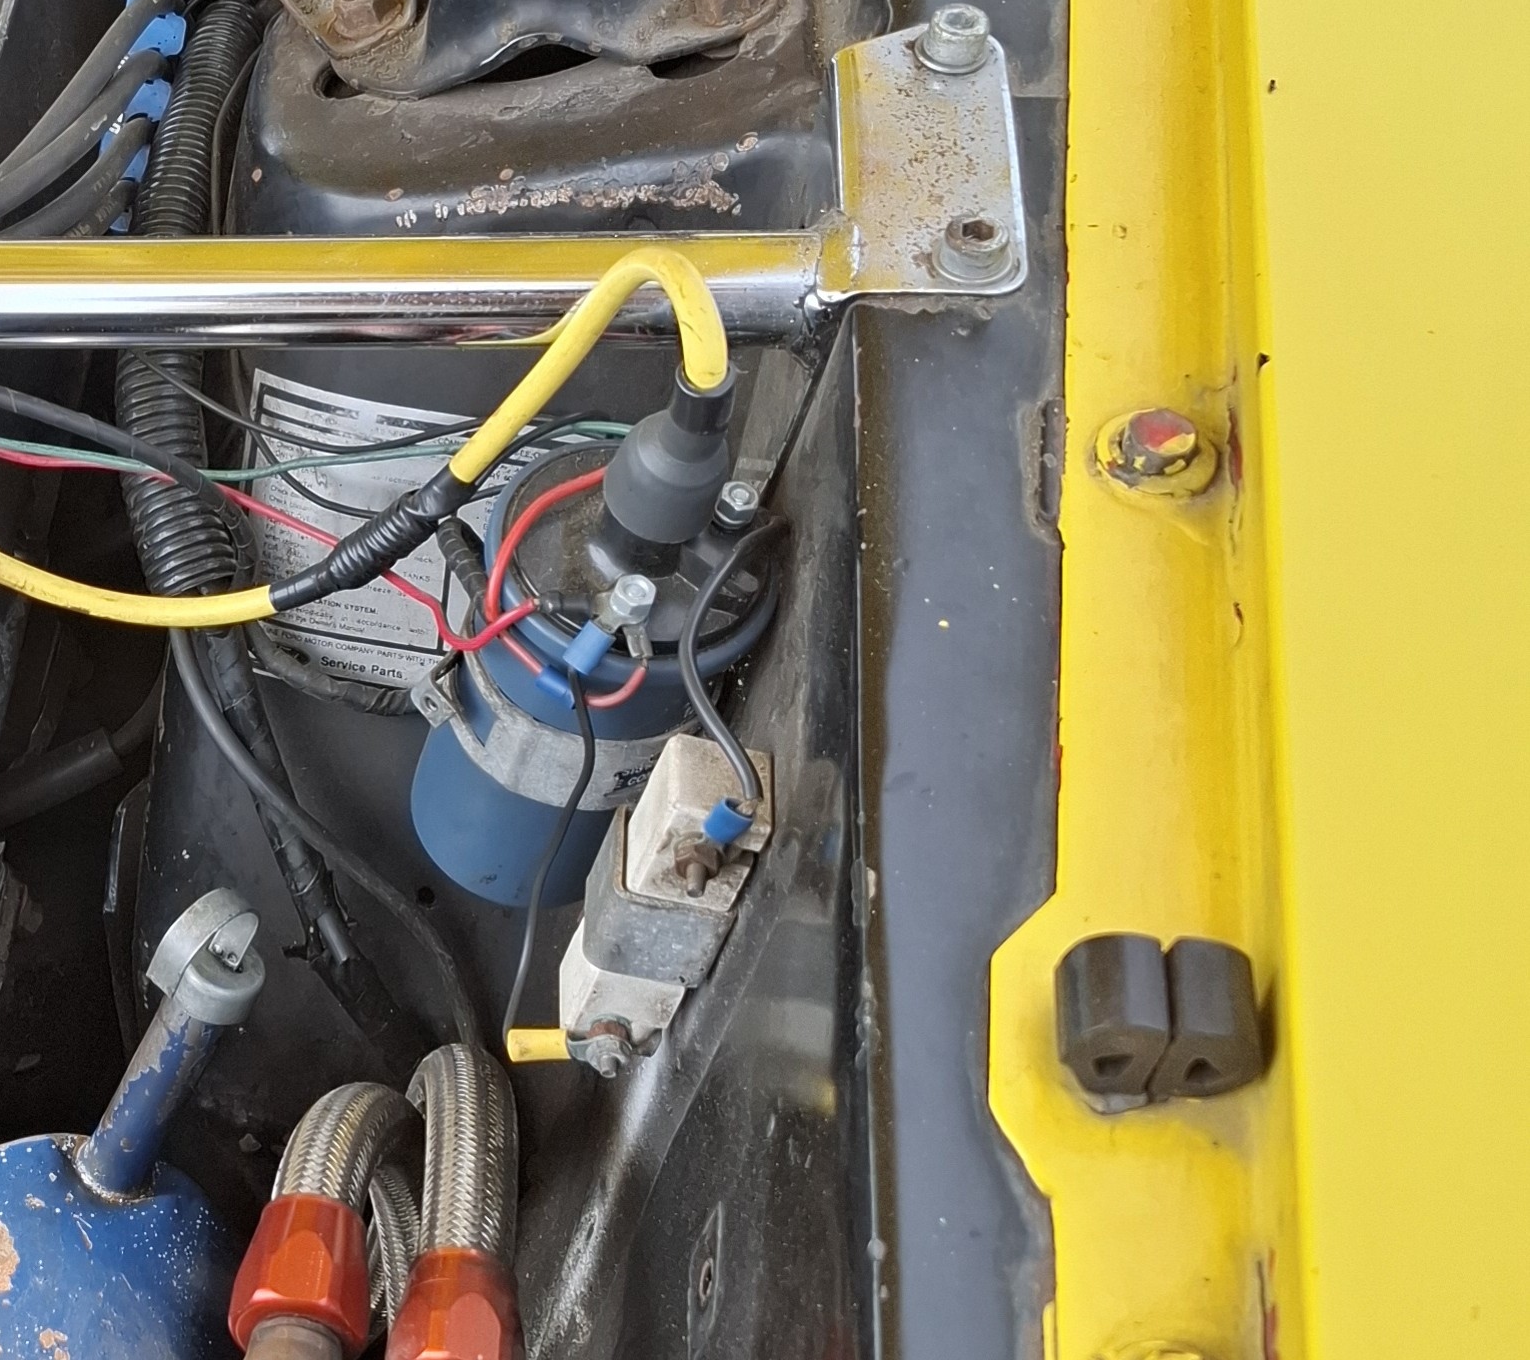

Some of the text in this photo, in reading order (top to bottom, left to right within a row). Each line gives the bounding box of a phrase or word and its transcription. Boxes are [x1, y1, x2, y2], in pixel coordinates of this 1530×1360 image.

[304, 636, 333, 648] MOTOR
[335, 643, 374, 655] COMPANY
[320, 655, 366, 673] Service
